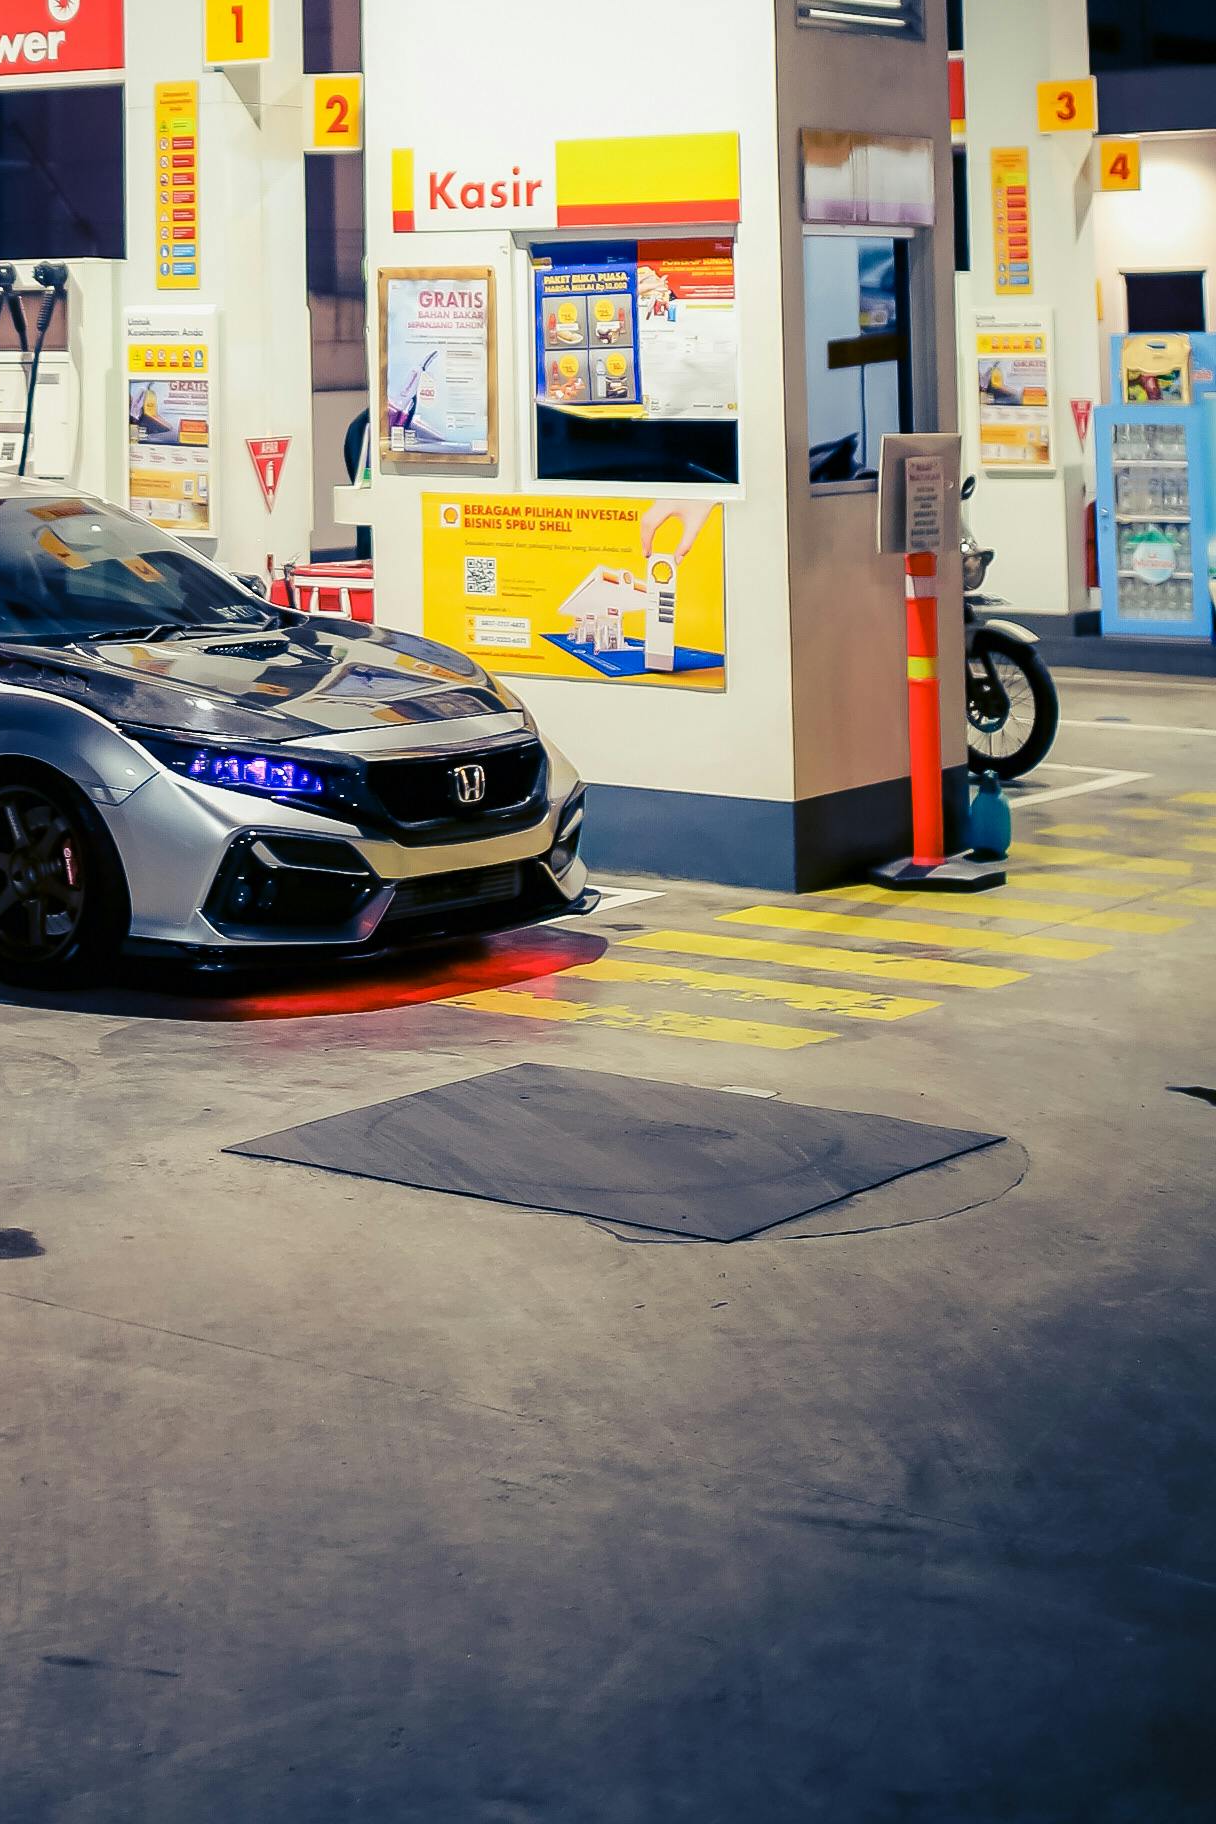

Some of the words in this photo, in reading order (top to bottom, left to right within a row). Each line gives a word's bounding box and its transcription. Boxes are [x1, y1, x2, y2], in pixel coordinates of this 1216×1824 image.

[231, 5, 244, 43] 1
[325, 94, 349, 133] 2
[1056, 91, 1076, 120] 3
[1109, 153, 1130, 180] 4
[428, 166, 543, 210] Kasir
[419, 290, 483, 308] GRATIS
[464, 504, 521, 517] BERAGAM
[525, 507, 573, 519] PILIHAN
[576, 509, 638, 522] INVESTASI
[464, 518, 502, 530] BISNIS
[506, 520, 535, 531] SPBU
[540, 521, 572, 532] SHELL
